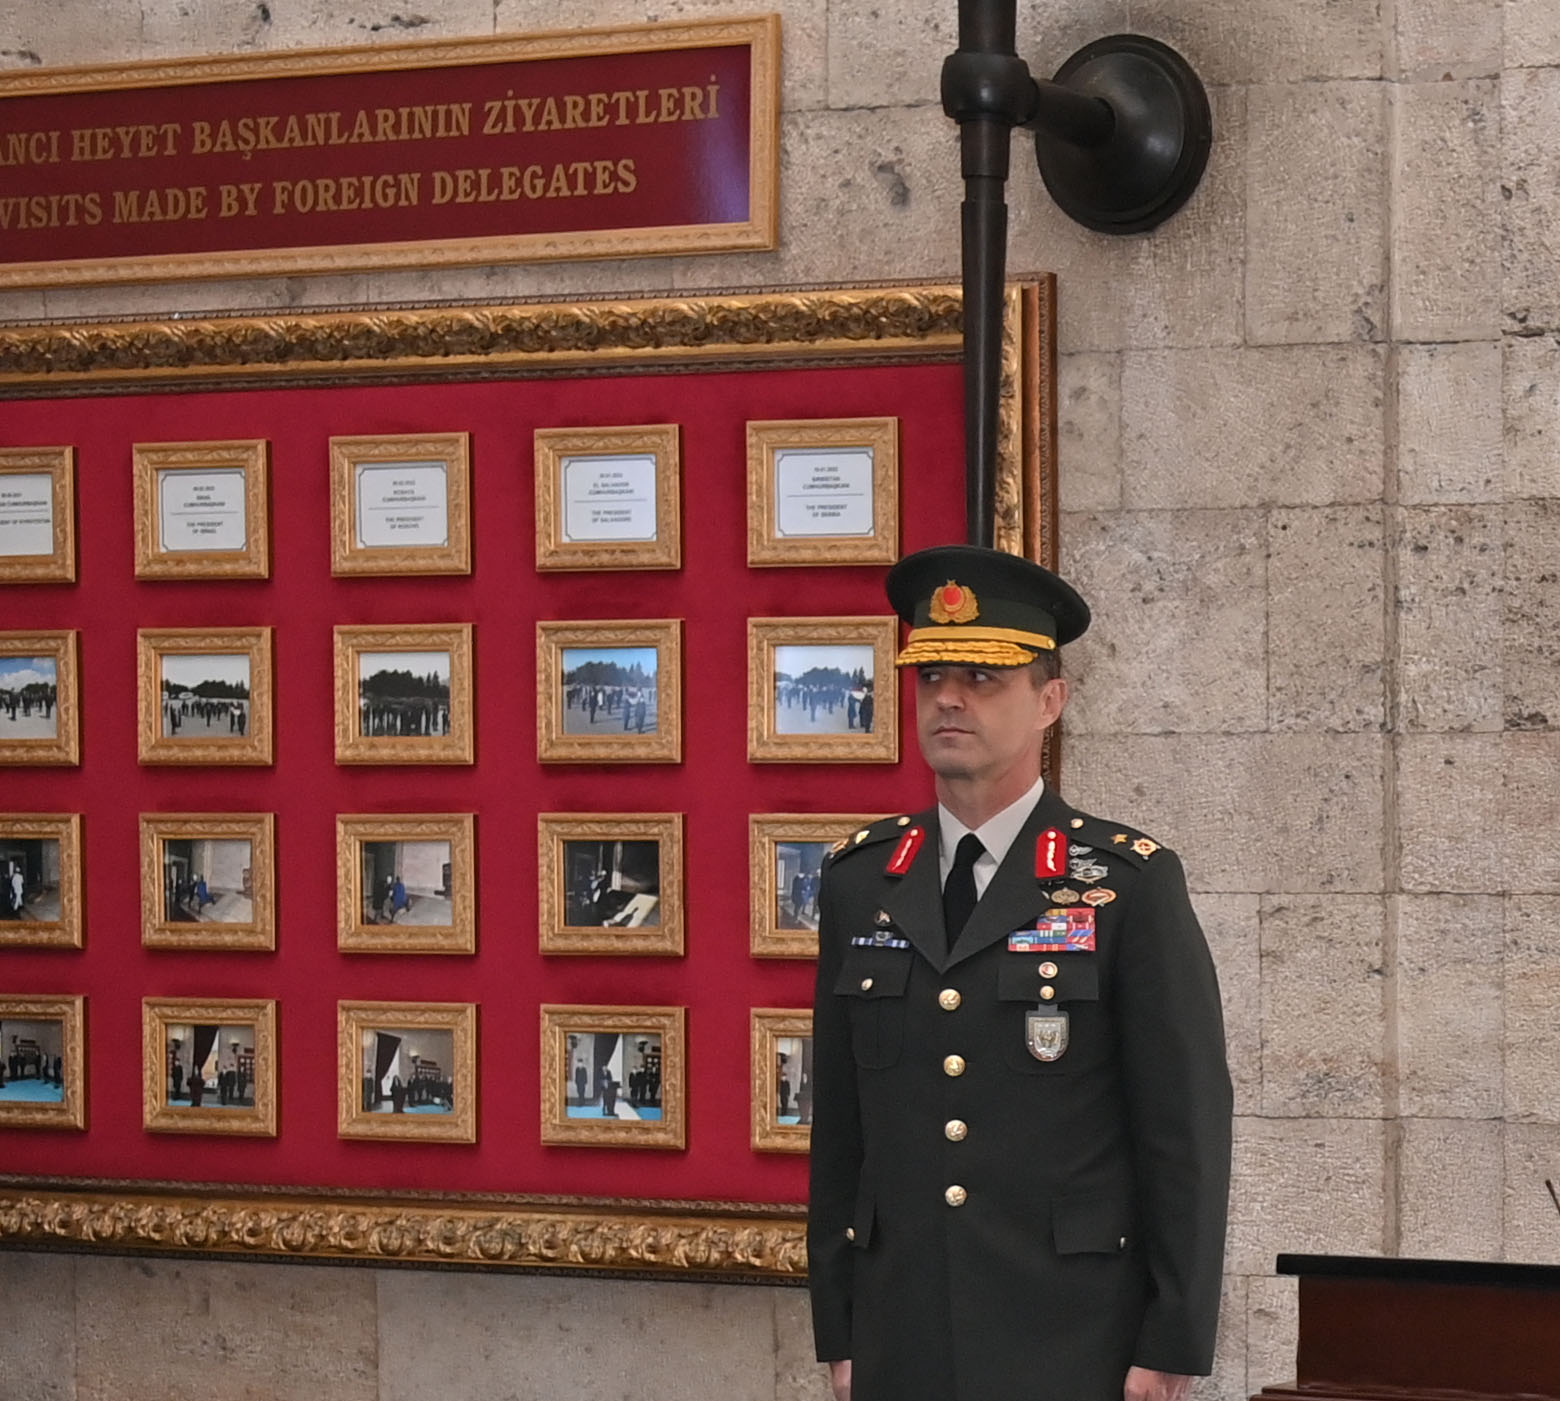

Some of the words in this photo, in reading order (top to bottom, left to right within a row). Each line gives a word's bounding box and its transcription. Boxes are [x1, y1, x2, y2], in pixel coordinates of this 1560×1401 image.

[0, 131, 61, 166] NCI
[71, 123, 181, 161] HEYET
[192, 103, 472, 160] BAŞKANLARININ
[483, 74, 720, 135] ZİYARETLERİ
[112, 186, 208, 224] MADE
[219, 183, 262, 218] BY
[273, 173, 421, 214] FOREIGN
[432, 158, 638, 204] DELEGATES
